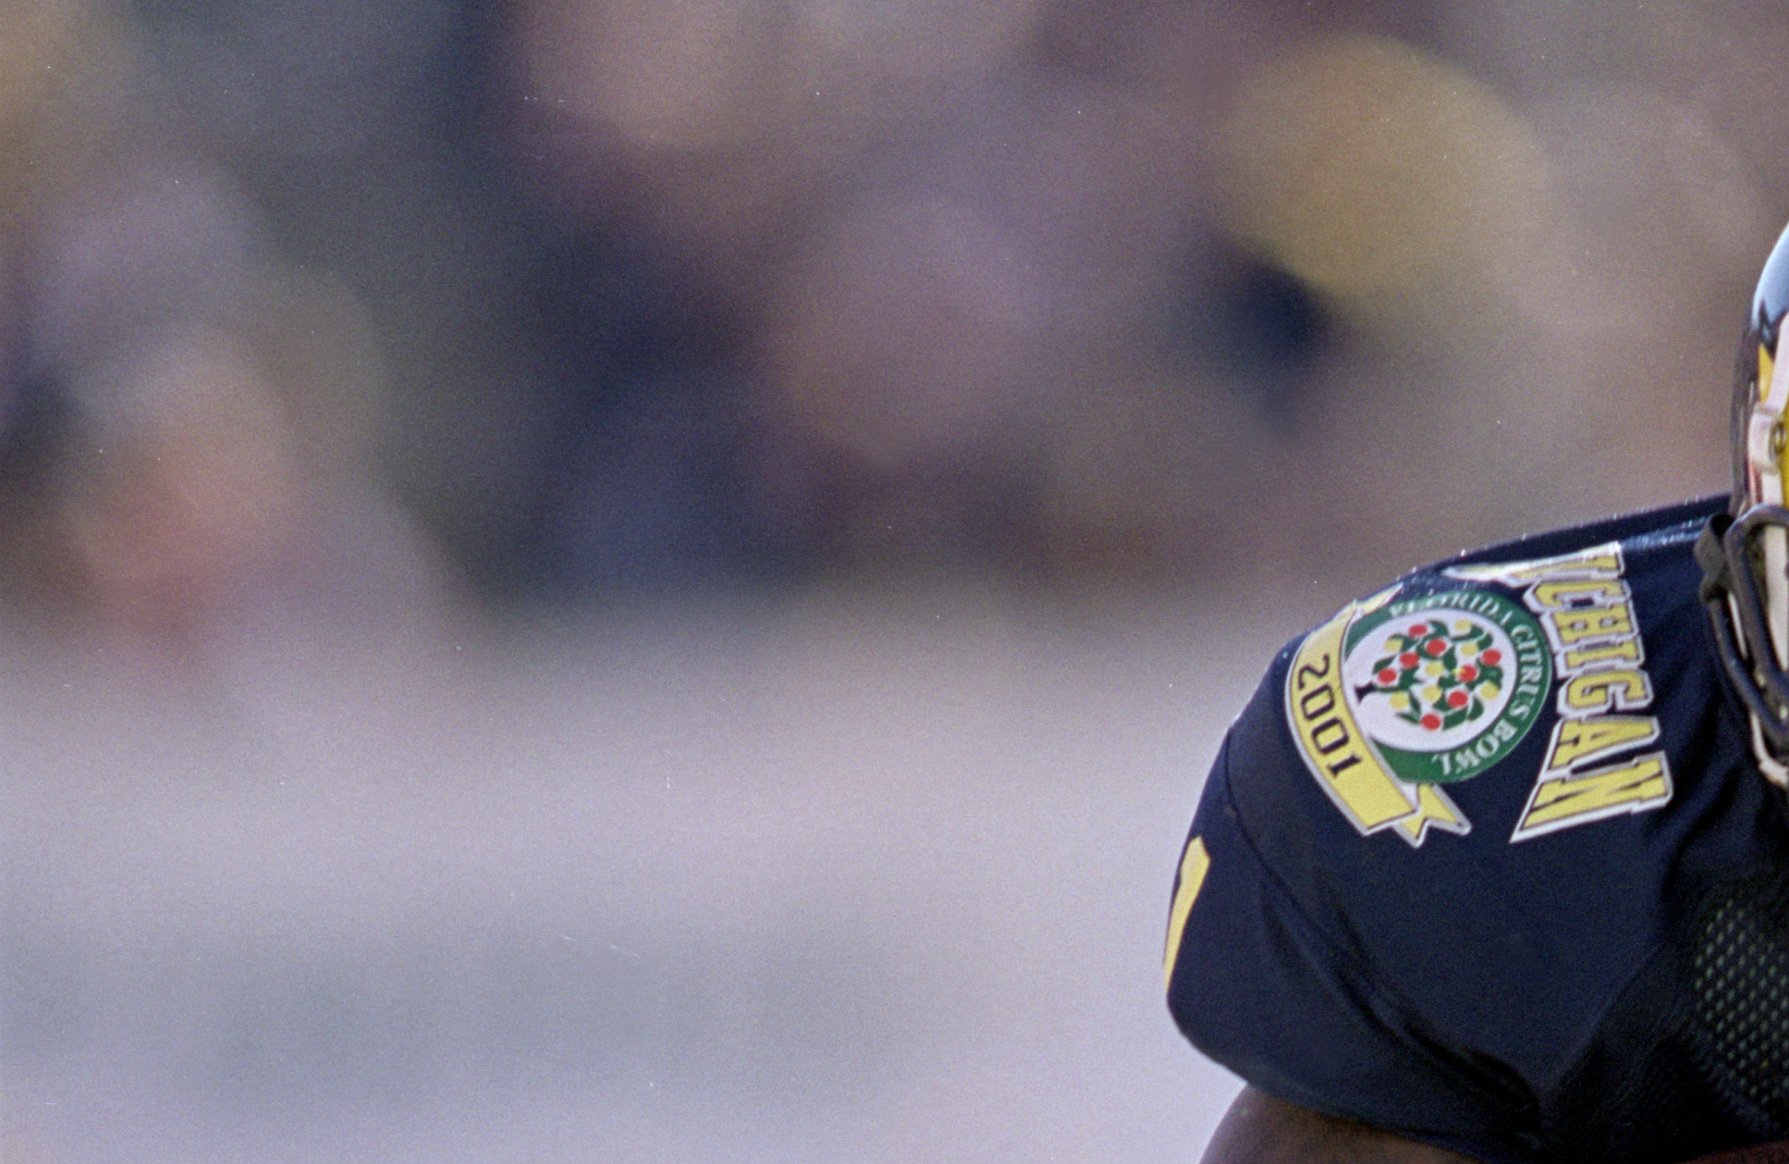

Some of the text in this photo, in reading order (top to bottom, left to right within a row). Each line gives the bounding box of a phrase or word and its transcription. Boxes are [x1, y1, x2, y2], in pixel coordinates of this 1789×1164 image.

[1297, 652, 1363, 780] 2001
[1443, 541, 1673, 843] ICHIGAN
[1511, 624, 1544, 719] CITRUS
[1431, 721, 1517, 776] BOWL
